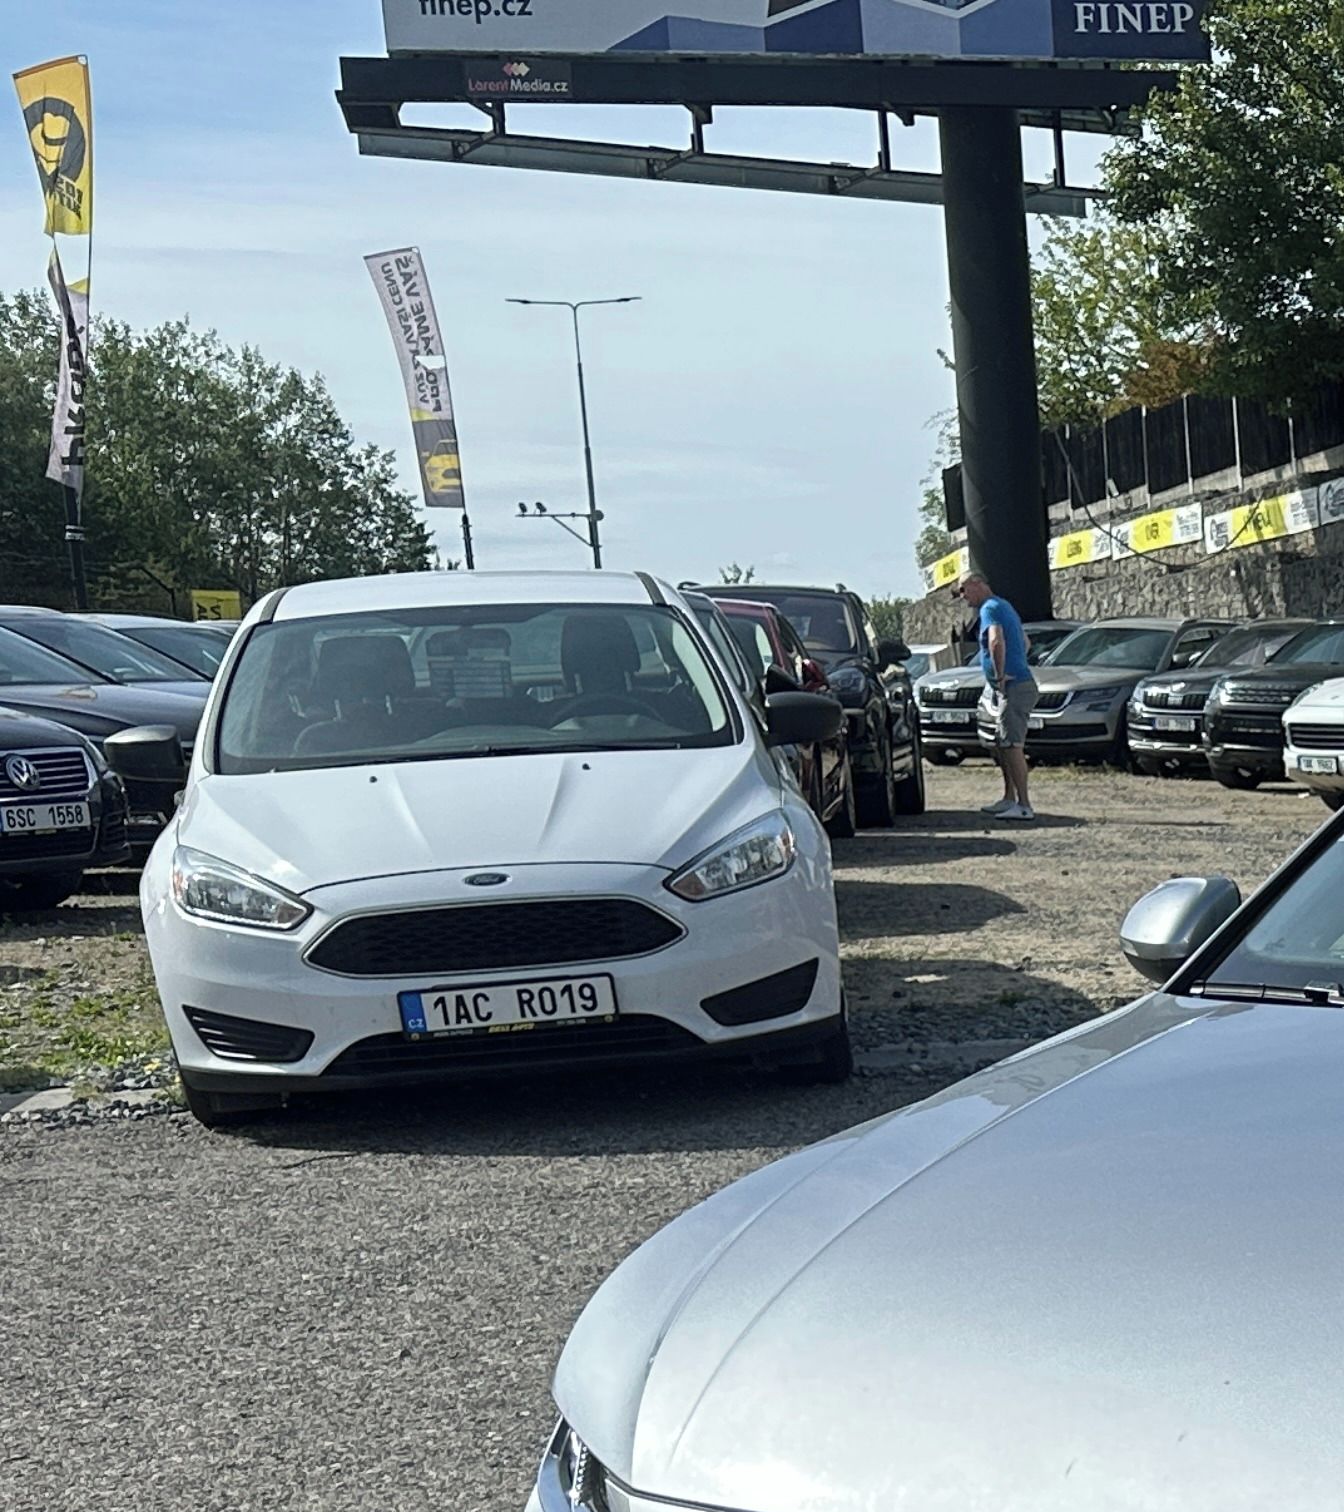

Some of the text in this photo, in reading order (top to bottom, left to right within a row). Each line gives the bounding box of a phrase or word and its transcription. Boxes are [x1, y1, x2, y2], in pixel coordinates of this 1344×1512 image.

[1074, 3, 1194, 33] FINEP
[6, 804, 84, 828] 6SC 1558
[408, 1018, 424, 1029] CZ
[433, 991, 493, 1027] 1AC
